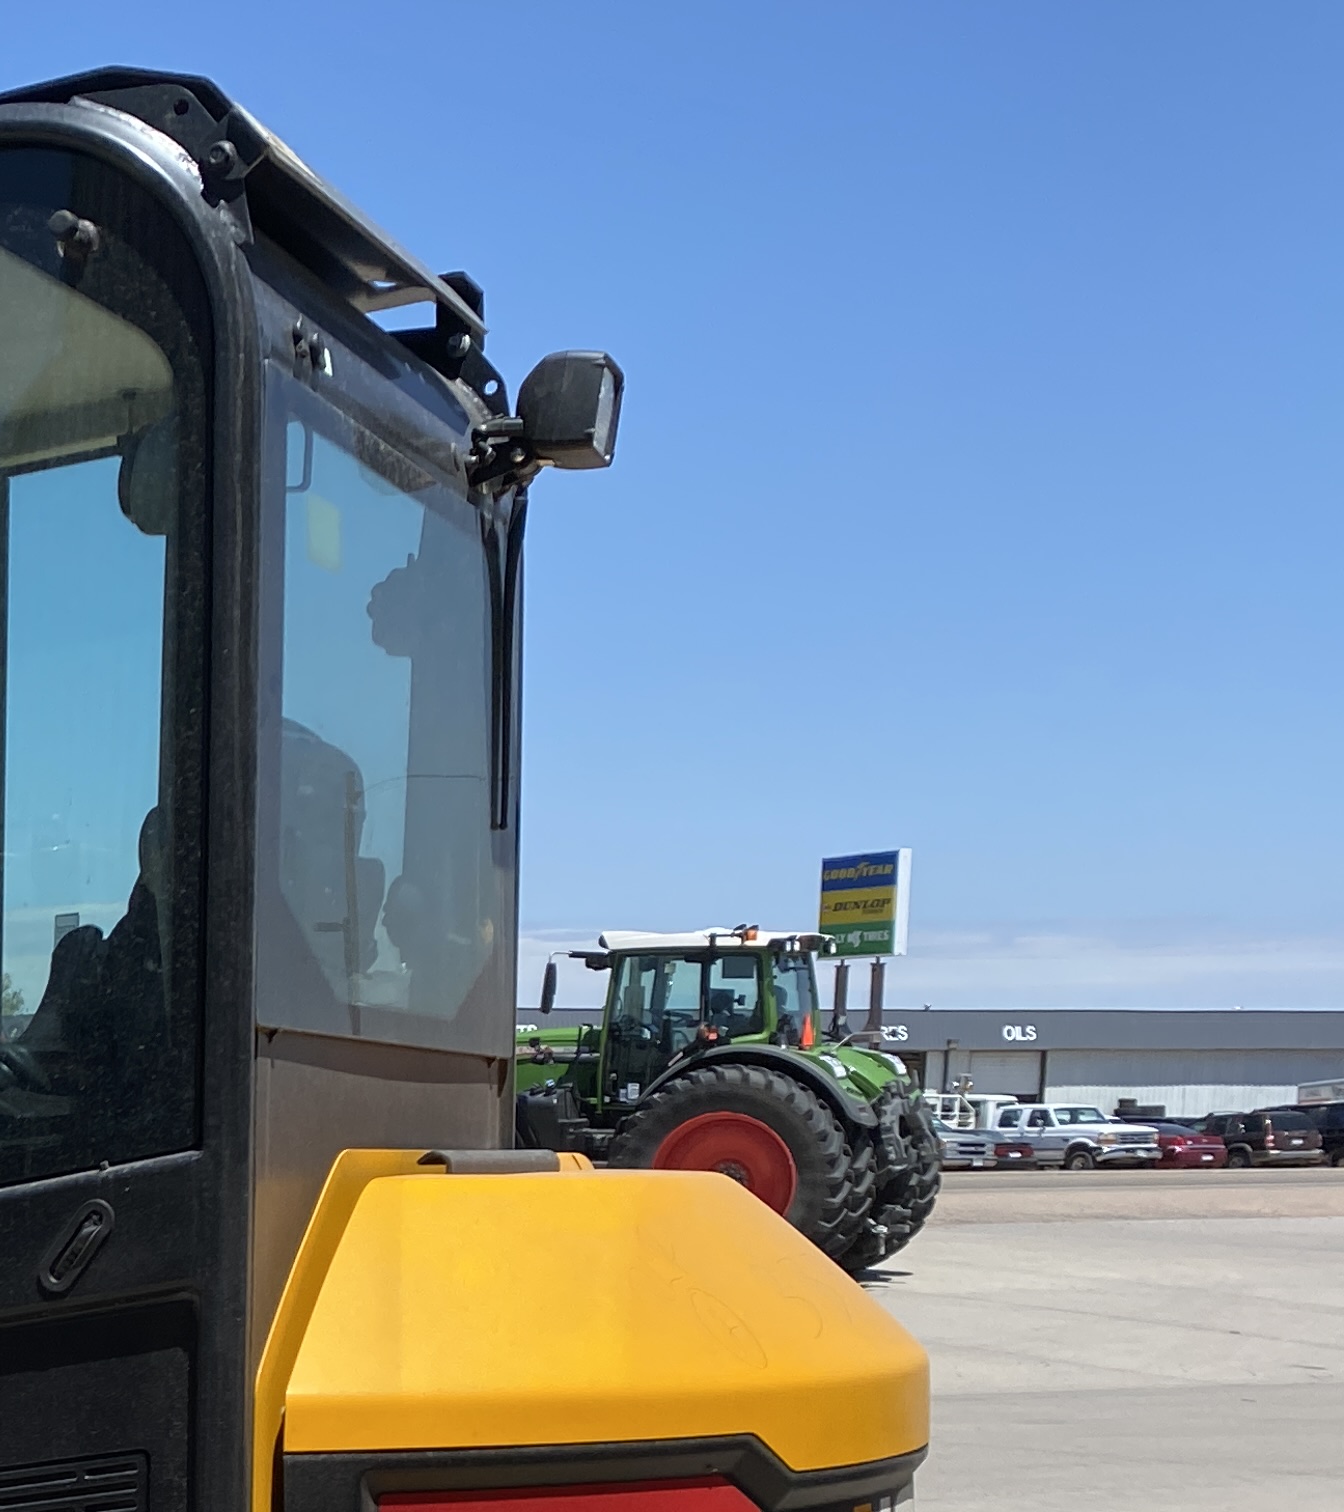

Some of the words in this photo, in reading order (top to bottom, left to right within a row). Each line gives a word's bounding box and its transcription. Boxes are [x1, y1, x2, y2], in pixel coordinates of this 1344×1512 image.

[832, 897, 892, 912] DUNLOP
[880, 1025, 908, 1041] RES
[1002, 1025, 1038, 1041] OILS
